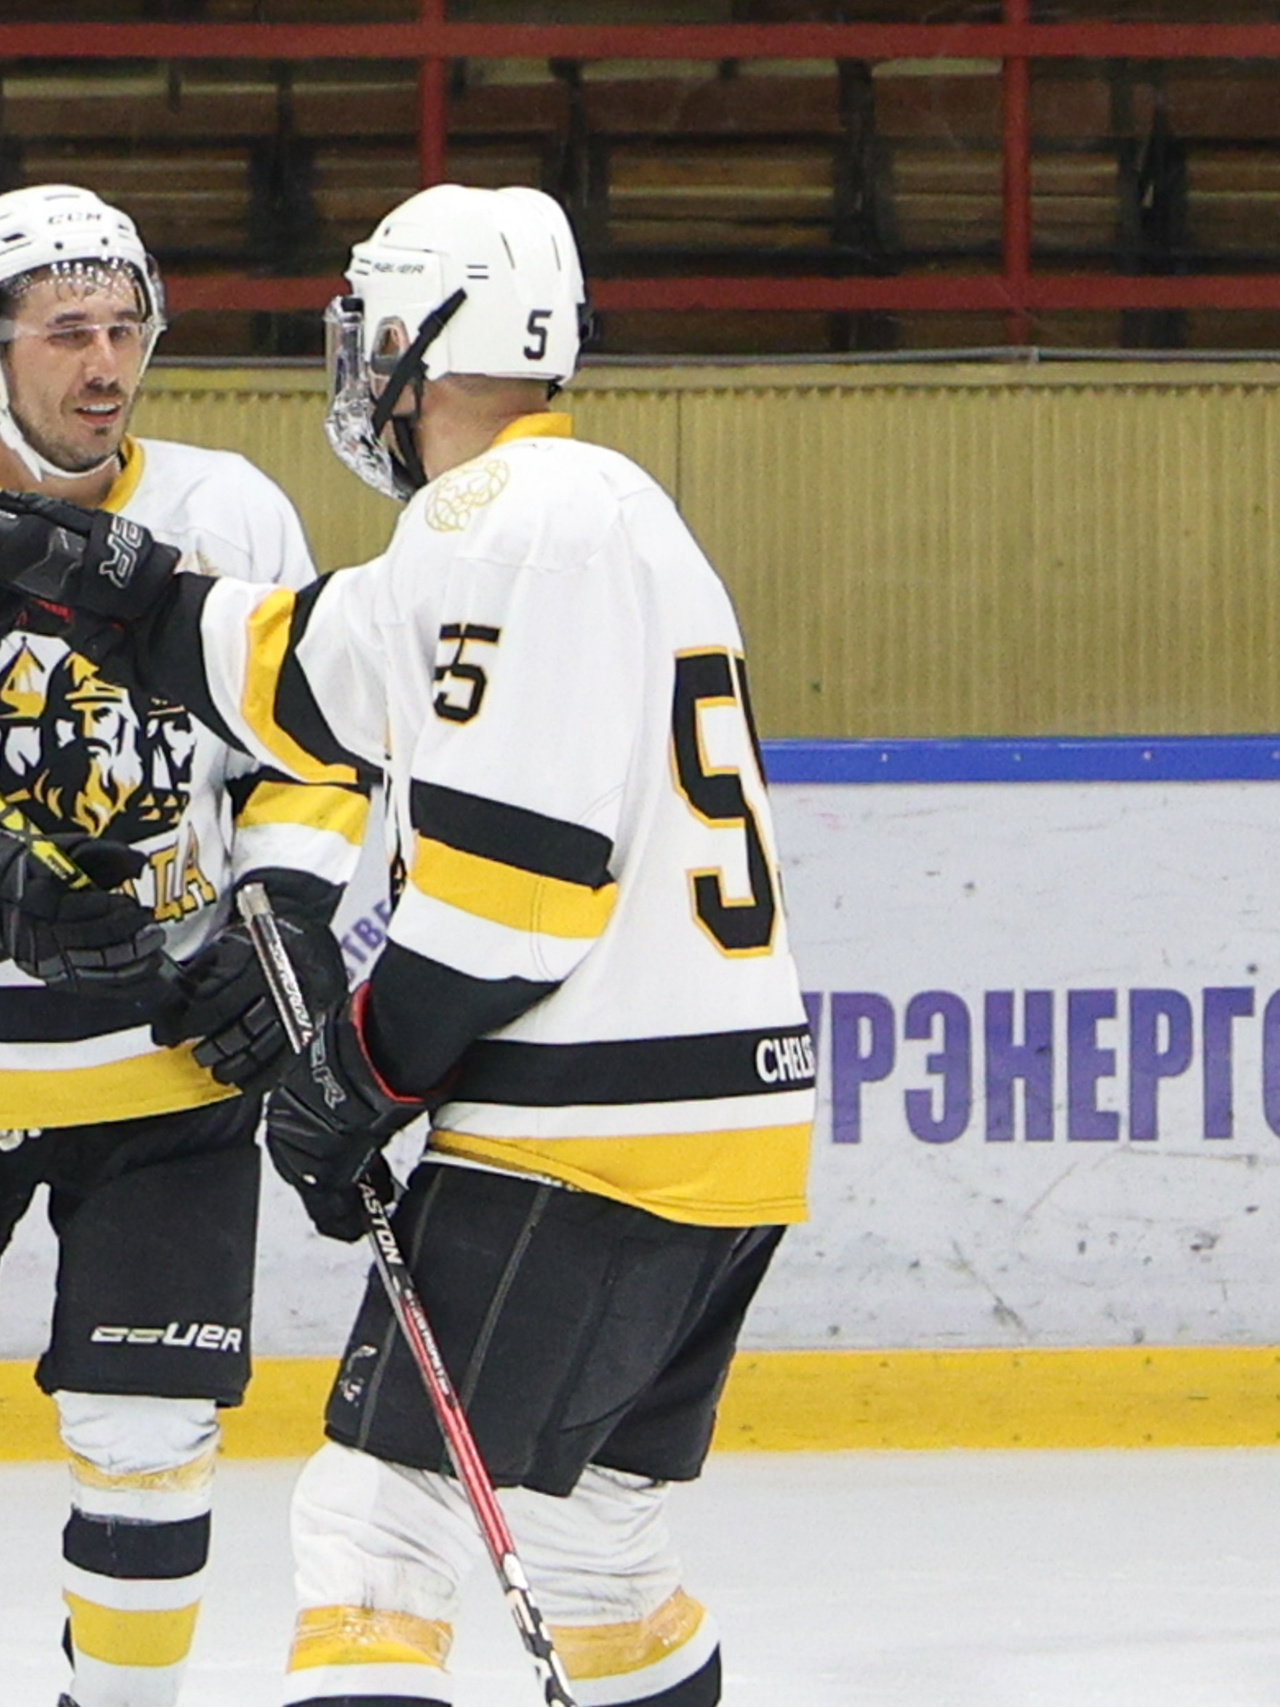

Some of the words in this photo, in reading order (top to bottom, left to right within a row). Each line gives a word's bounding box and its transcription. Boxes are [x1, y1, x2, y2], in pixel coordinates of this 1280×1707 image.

[523, 309, 553, 361] 5
[802, 986, 1280, 1145] РЭНЕРГ
[357, 1173, 405, 1266] ASTON
